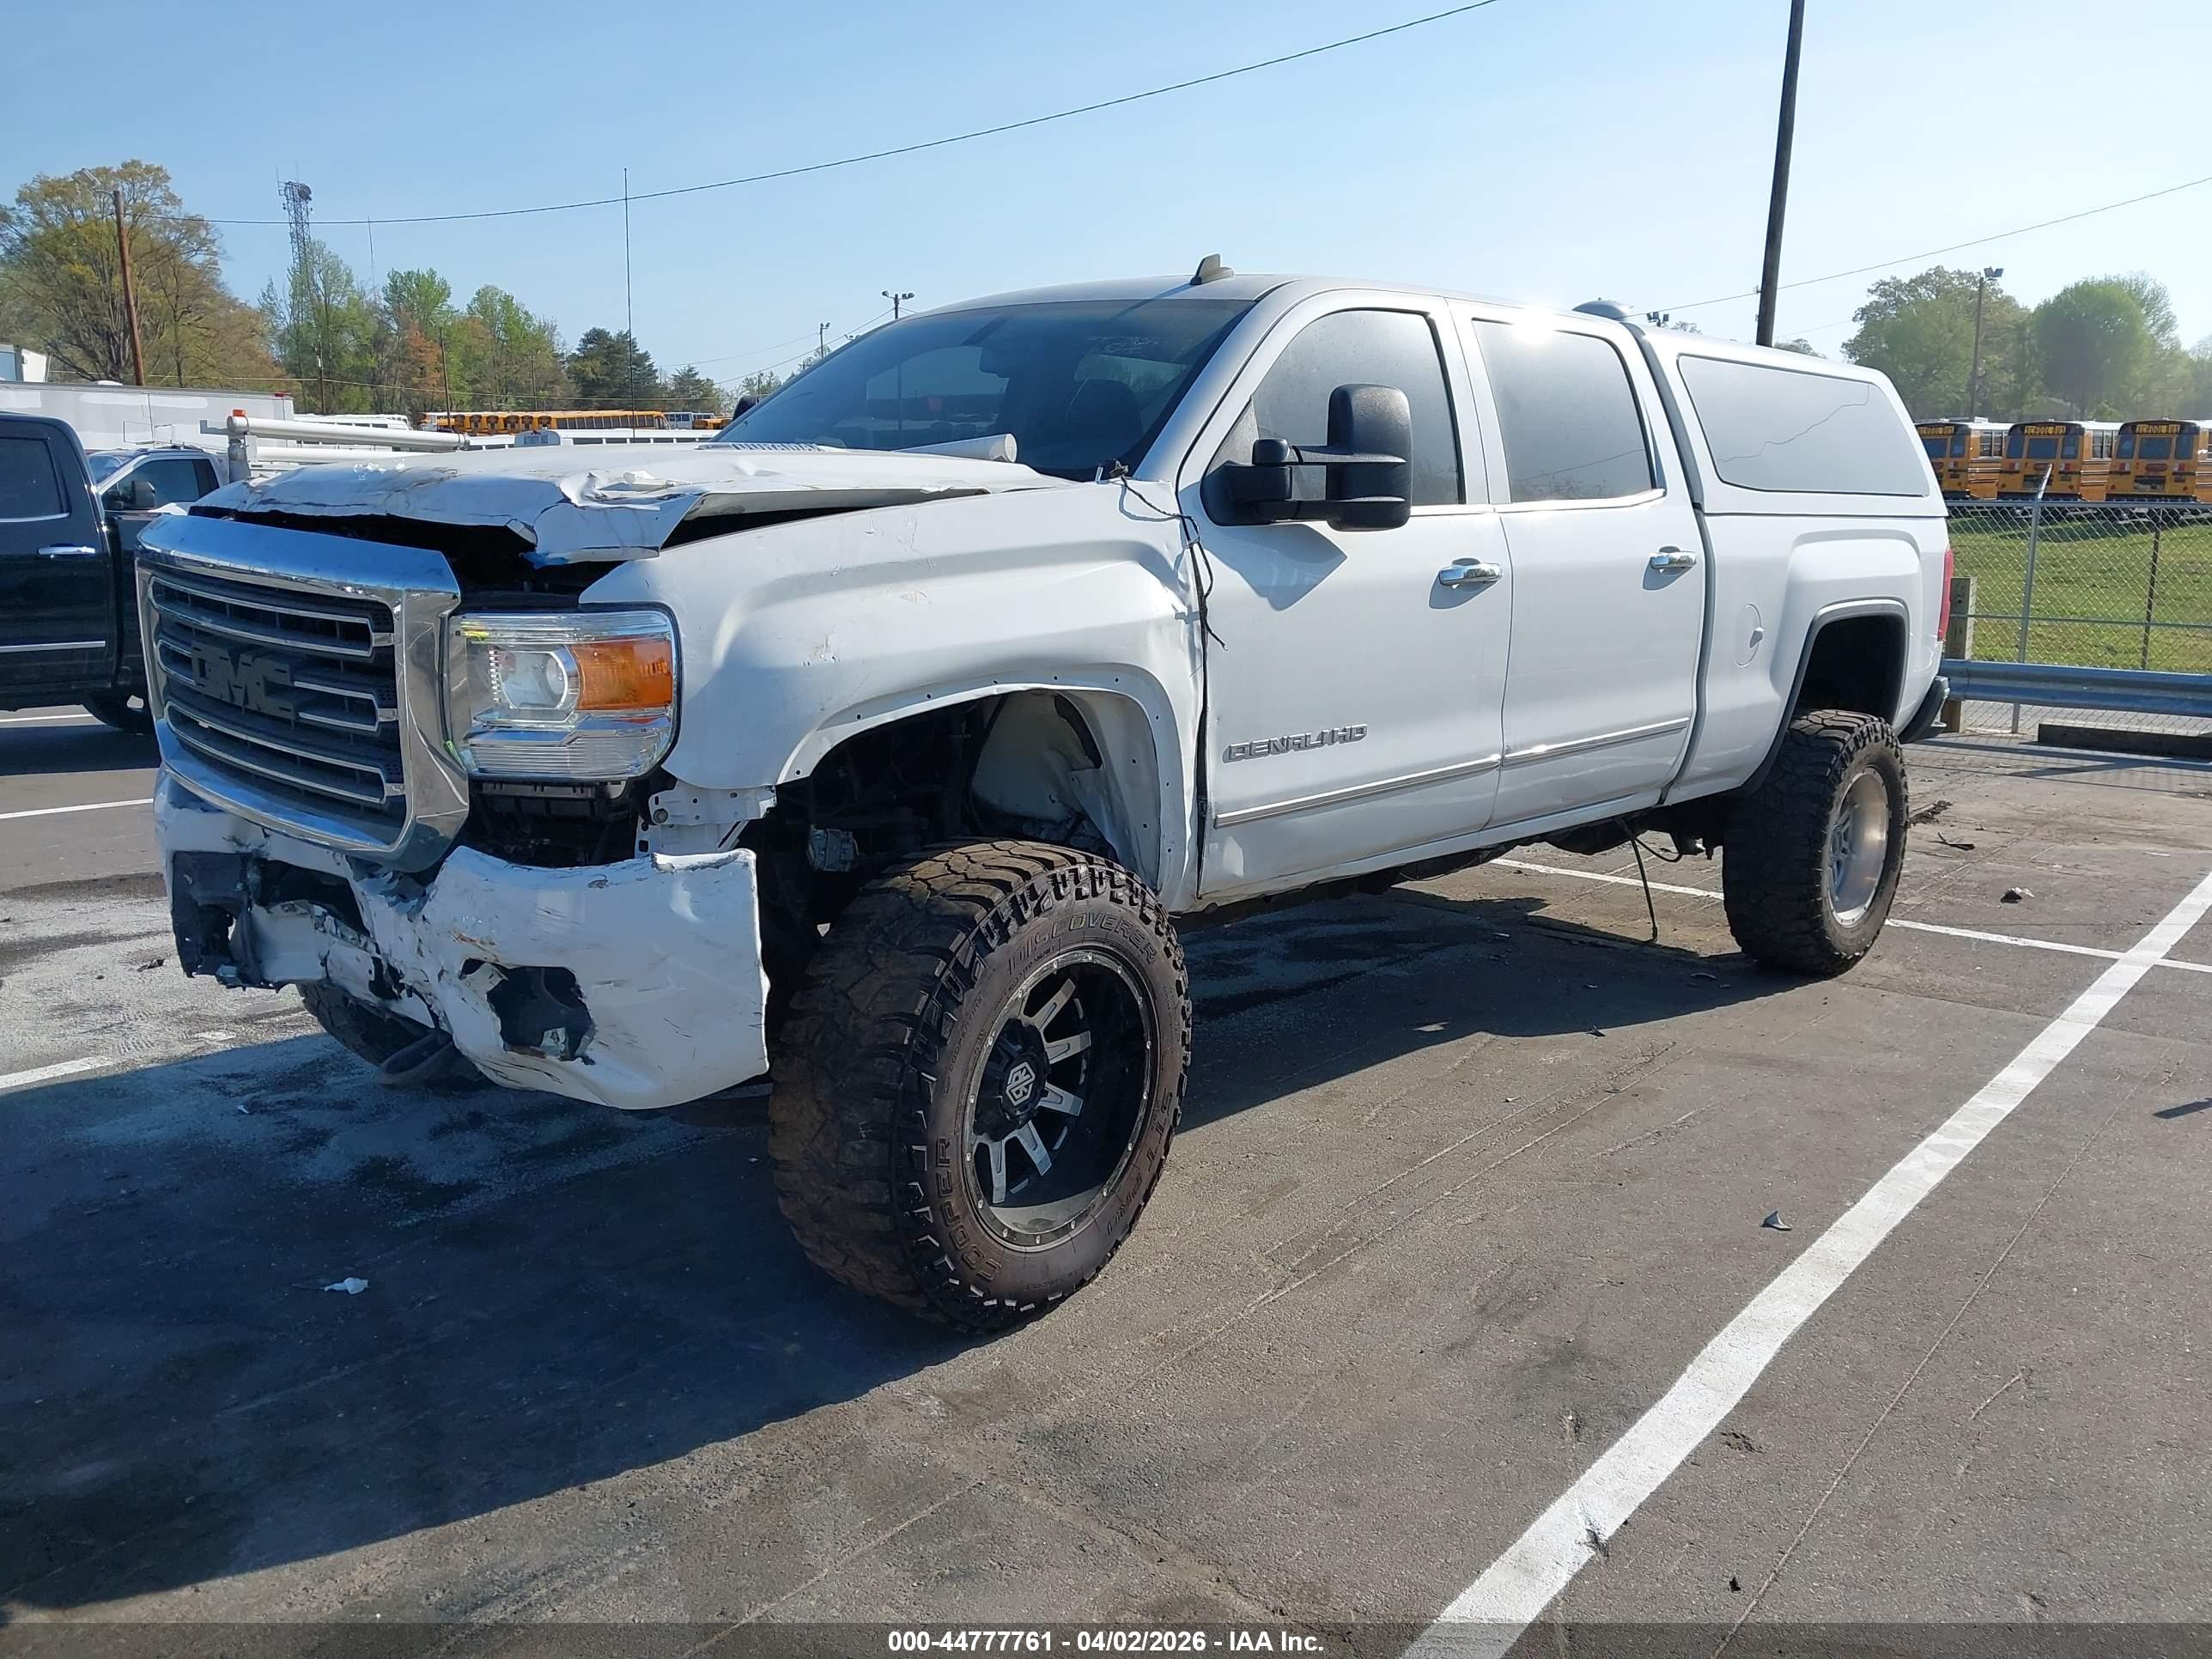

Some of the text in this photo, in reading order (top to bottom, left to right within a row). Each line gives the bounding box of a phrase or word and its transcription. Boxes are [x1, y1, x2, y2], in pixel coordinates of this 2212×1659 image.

[191, 641, 296, 721] GMC
[1222, 723, 1368, 764] DENALI HD
[1007, 912, 1158, 976] DISCOVERER
[935, 1137, 1003, 1282] COOPER
